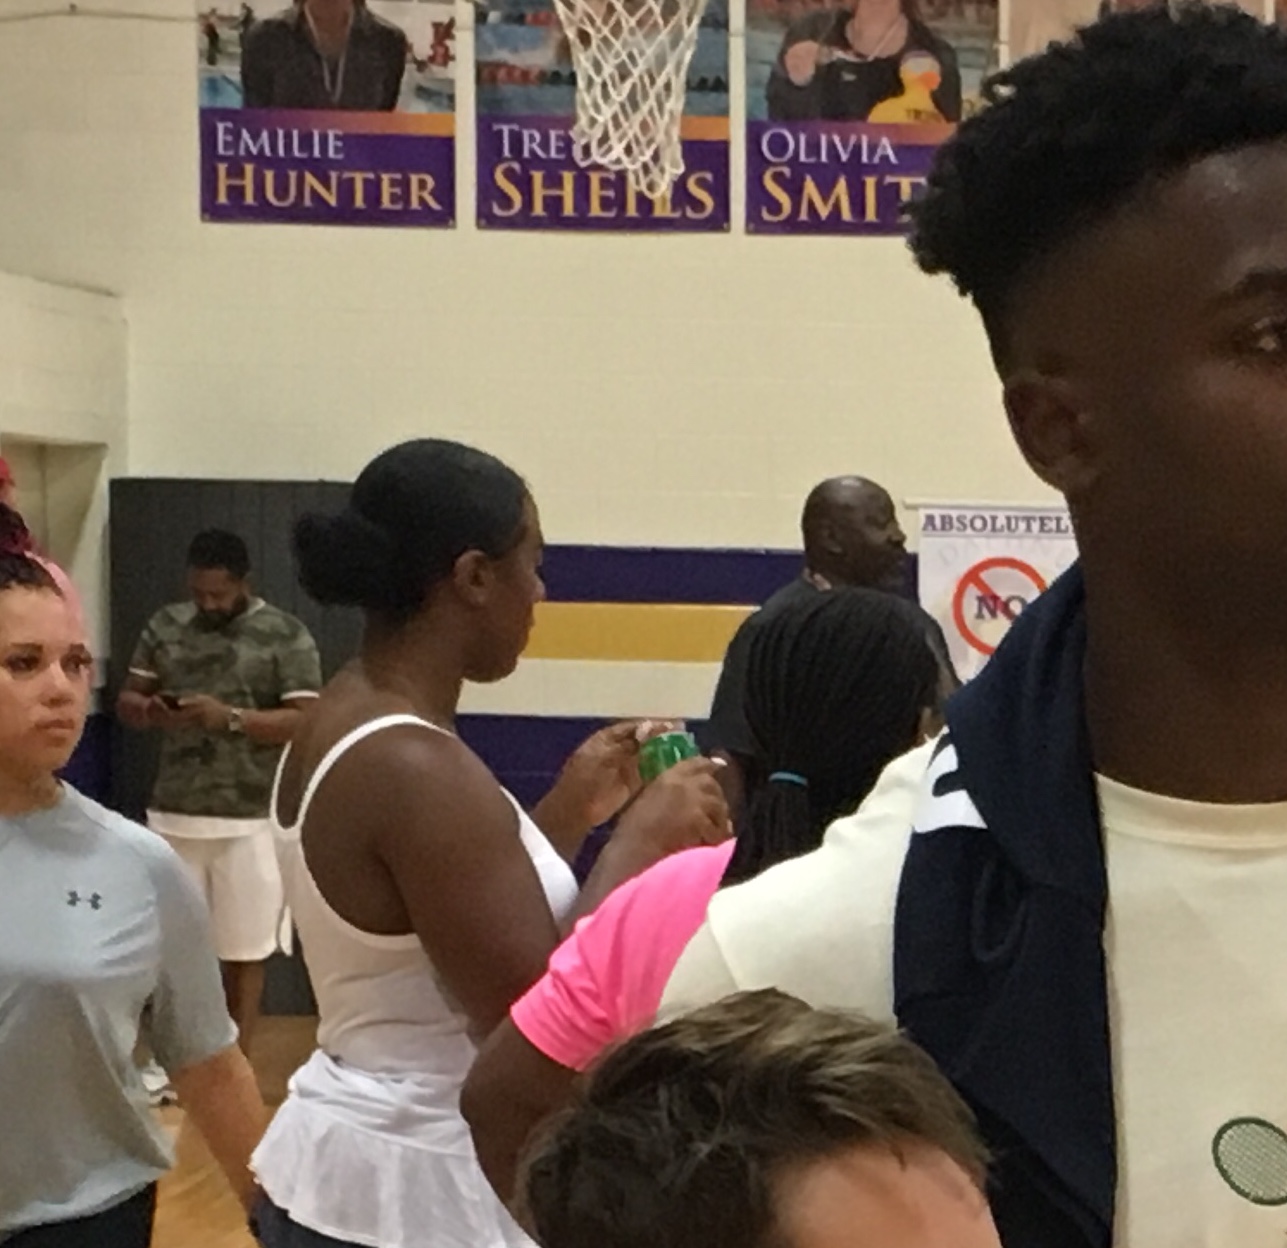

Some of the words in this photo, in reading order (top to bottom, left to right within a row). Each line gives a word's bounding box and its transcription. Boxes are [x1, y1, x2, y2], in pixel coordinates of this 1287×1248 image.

[215, 121, 345, 159] EMILIE
[492, 122, 575, 160] TRE
[761, 128, 898, 164] OLIVIA
[215, 162, 443, 211] HUNTER
[761, 165, 928, 222] SMIT
